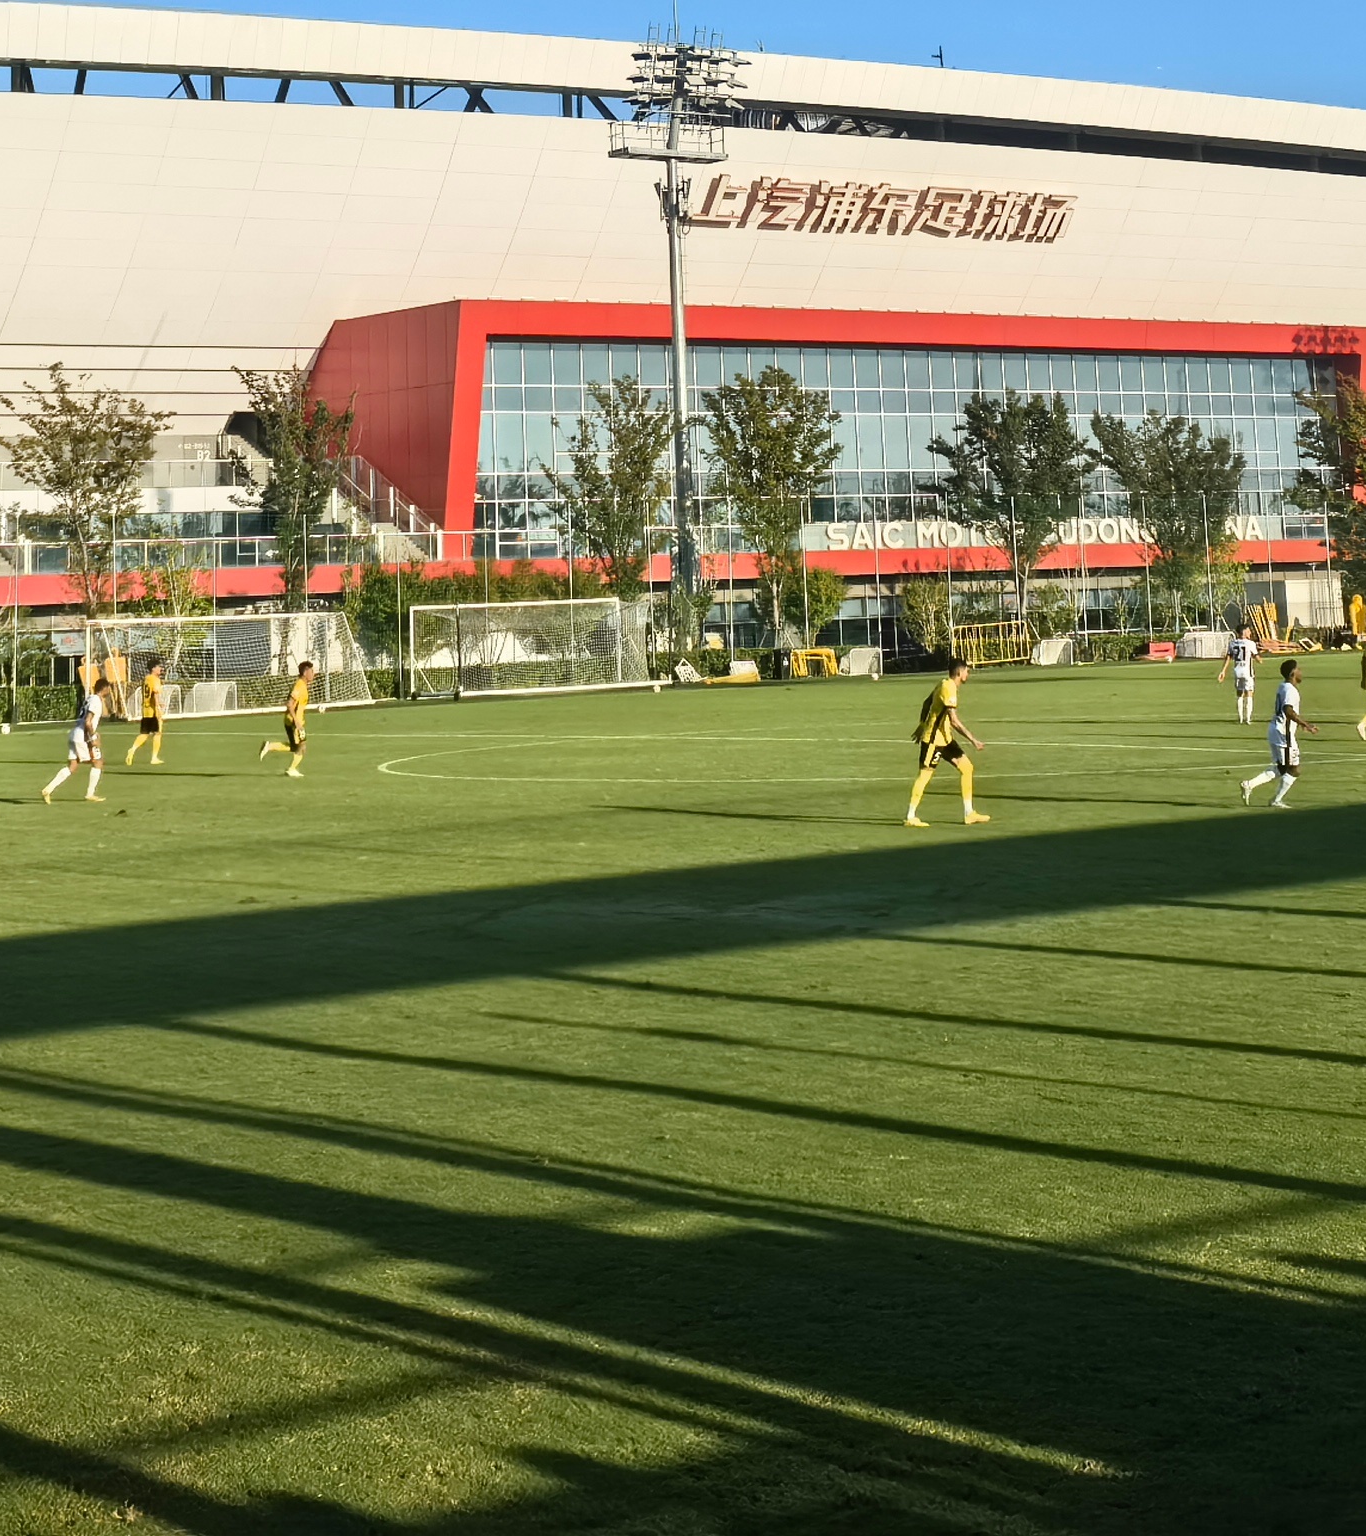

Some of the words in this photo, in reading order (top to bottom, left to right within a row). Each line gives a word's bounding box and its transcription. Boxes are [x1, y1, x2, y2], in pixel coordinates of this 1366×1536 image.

[691, 173, 1079, 243] 上汽浦东足球场
[826, 521, 904, 551] SAIC
[1233, 646, 1246, 662] 21
